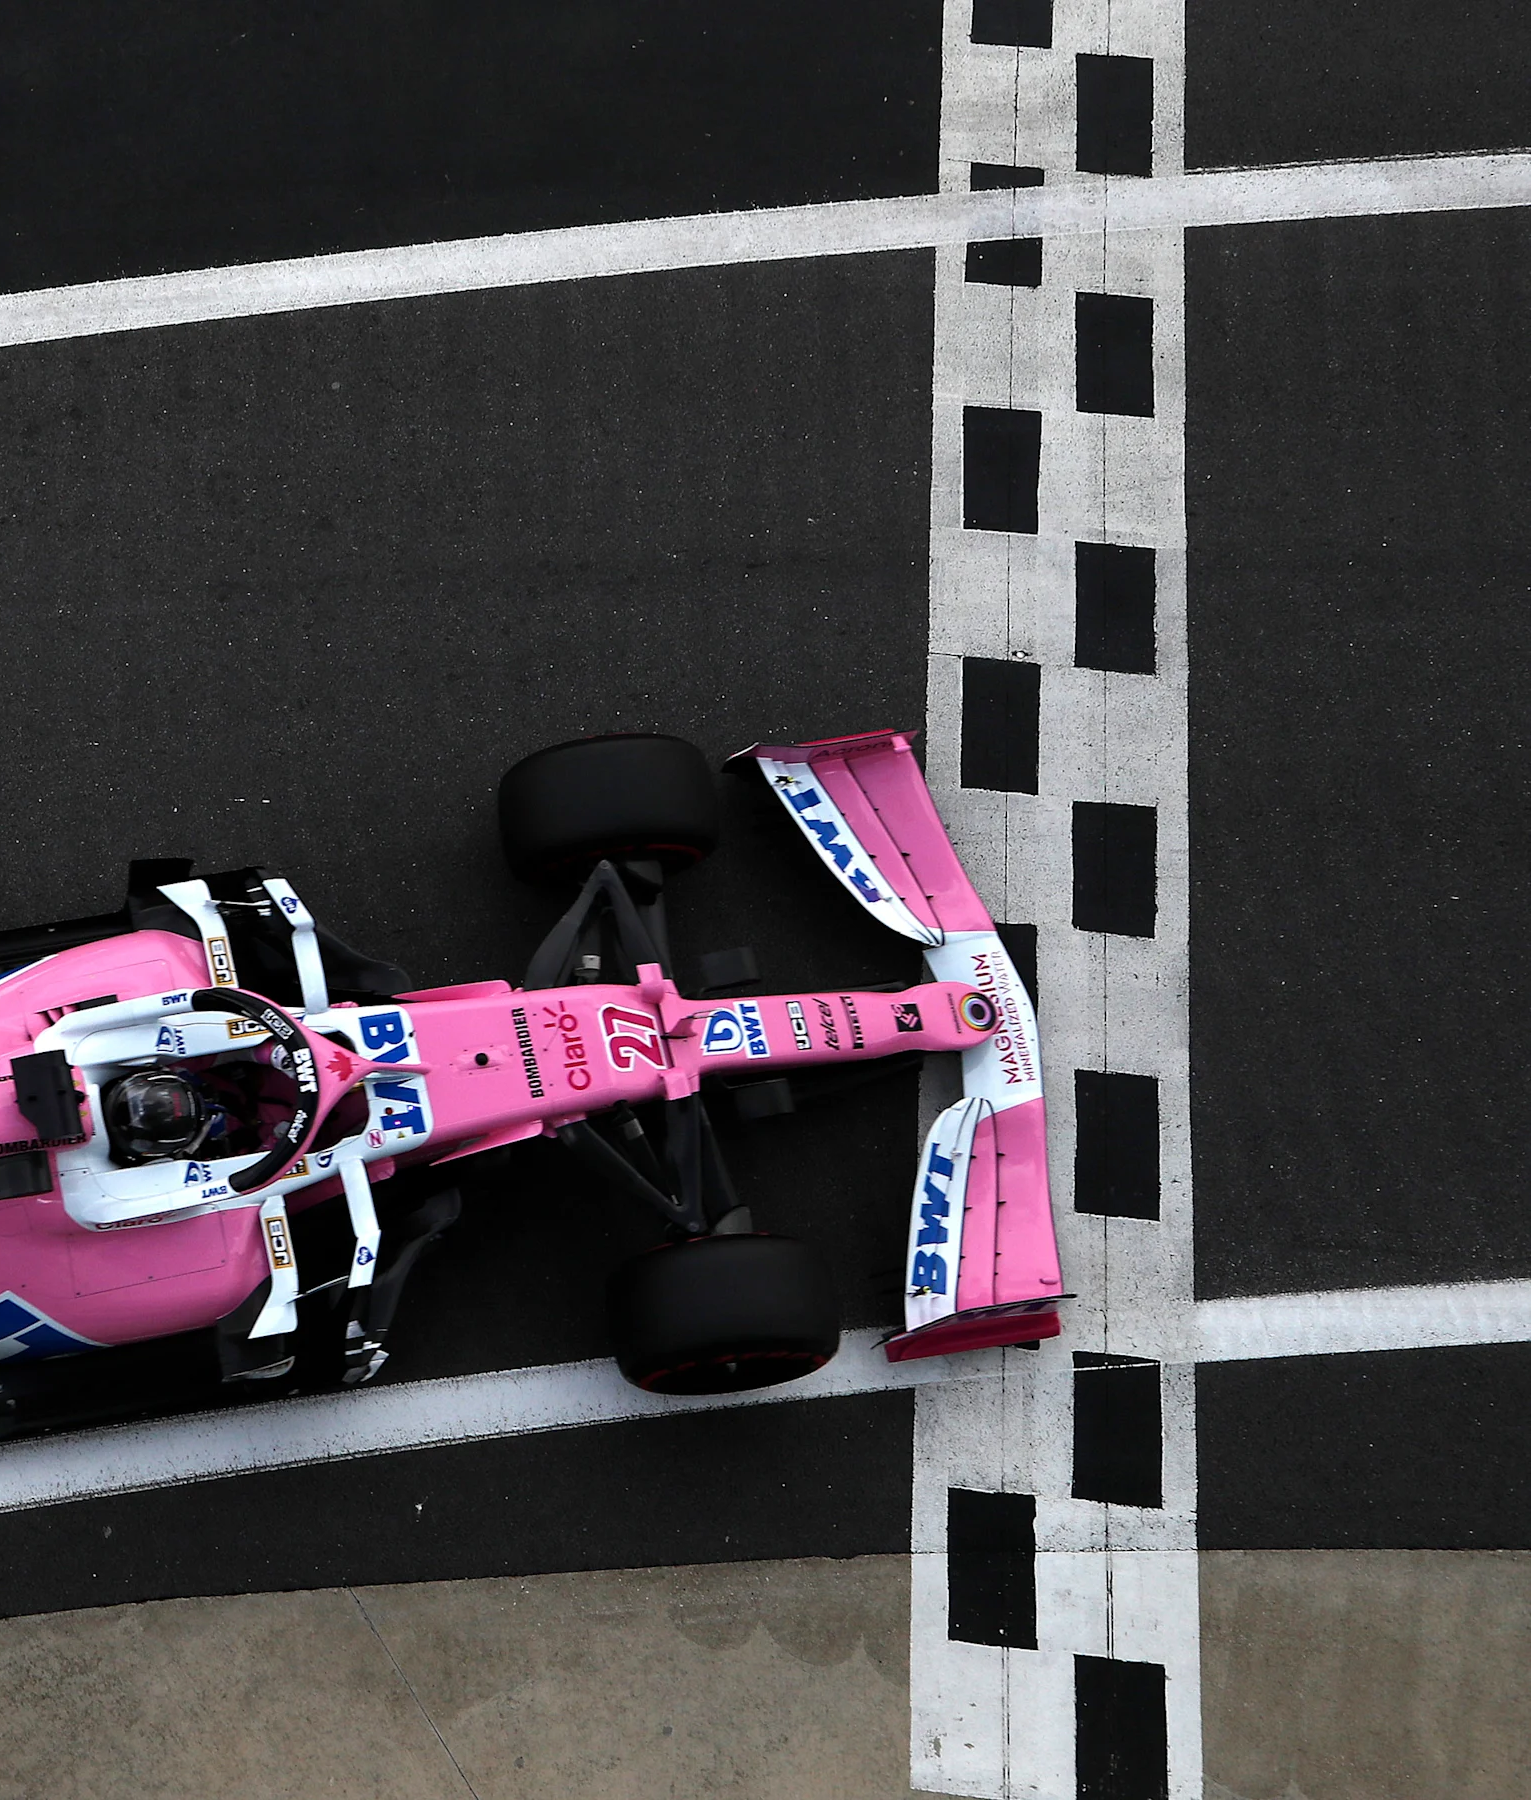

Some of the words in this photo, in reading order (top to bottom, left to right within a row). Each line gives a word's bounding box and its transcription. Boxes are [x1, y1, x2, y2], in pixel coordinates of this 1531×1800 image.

[162, 993, 187, 1006] BWT
[740, 1003, 767, 1056] BWT
[786, 1001, 812, 1050] JCB
[511, 1008, 545, 1098] BOMBARDIER
[559, 1013, 591, 1090] Claro
[598, 1004, 666, 1071] 27
[292, 1048, 318, 1093] BWT
[911, 1142, 954, 1295] BWT
